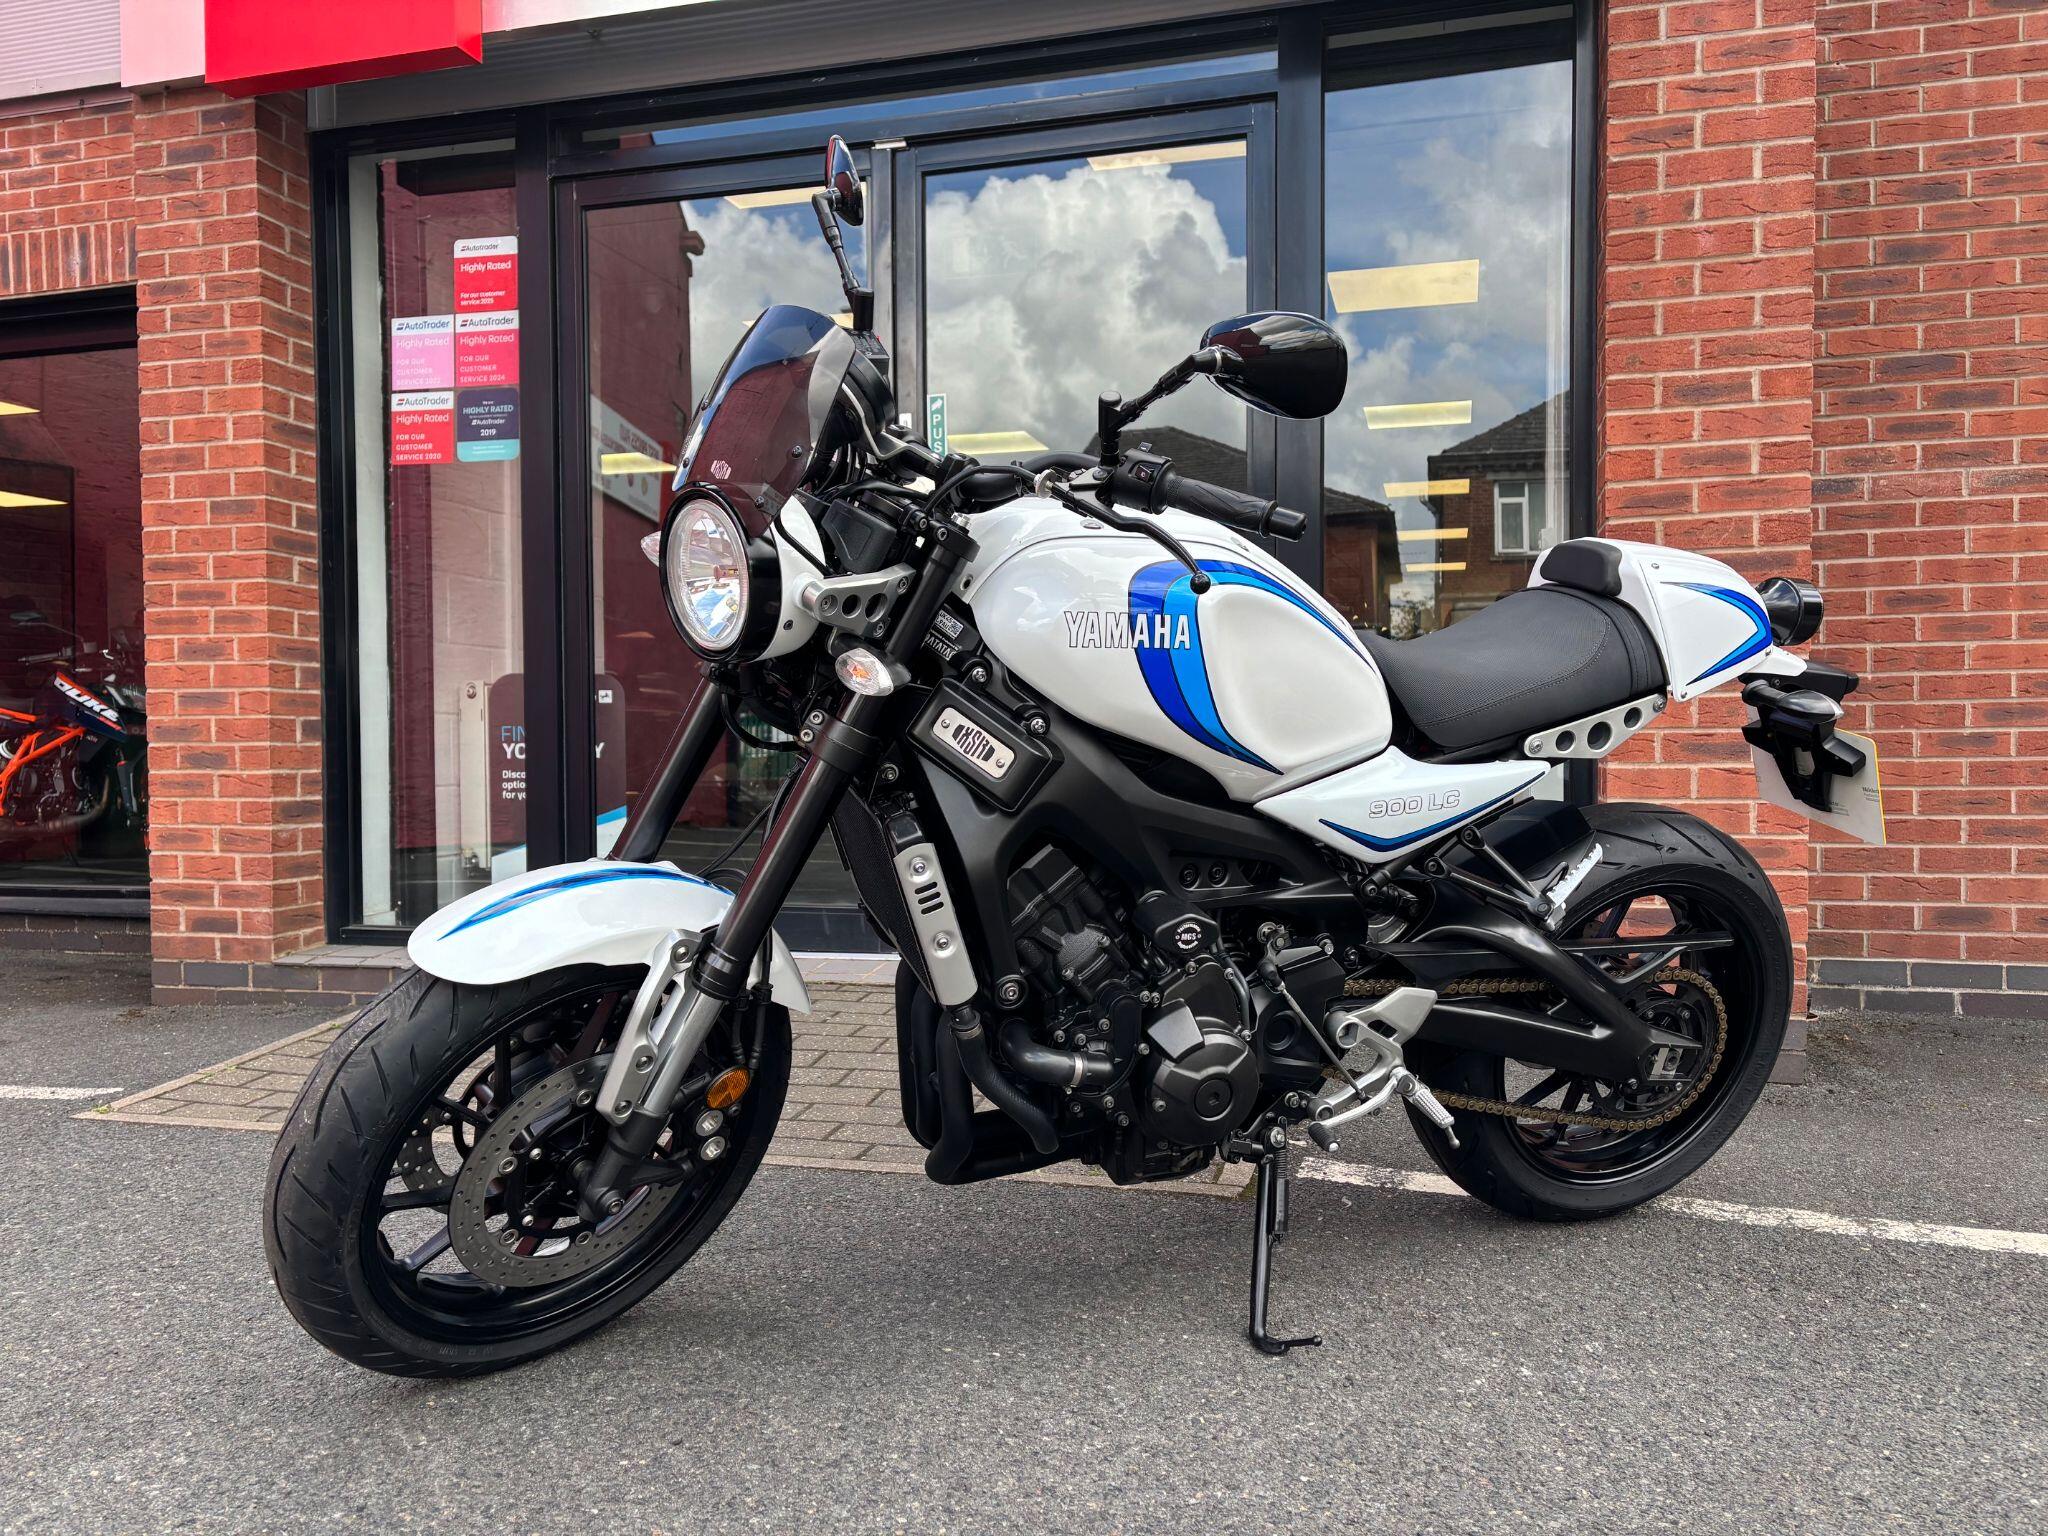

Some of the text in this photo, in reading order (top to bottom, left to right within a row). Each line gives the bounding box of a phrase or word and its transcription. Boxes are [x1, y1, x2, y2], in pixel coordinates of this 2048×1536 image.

[460, 260, 512, 274] Highly Rated
[404, 320, 450, 331] AutoTrader
[468, 316, 514, 327] AutoTrader
[397, 336, 449, 349] Highly Rated
[460, 333, 514, 346] Highly Rated
[460, 364, 497, 373] CUSTOMER
[460, 374, 487, 383] SERVICE
[405, 396, 450, 406] AutoTrader
[462, 404, 514, 415] HIGHLY RATED
[396, 412, 449, 426] Highly Rated
[396, 433, 410, 441] FOR
[480, 428, 497, 437] 2019
[933, 414, 943, 453] PUS
[396, 443, 433, 451] CUSTOMER
[396, 453, 423, 461] SERVICE
[1064, 611, 1191, 649] YAMAHA
[54, 676, 119, 722] DUKE
[501, 726, 525, 742] FIN
[955, 725, 991, 761] XSR
[502, 742, 526, 759] YO
[502, 770, 526, 779] Disco
[502, 780, 526, 791] optio
[502, 790, 526, 800] for yo
[1368, 790, 1460, 818] 900 LC
[1181, 932, 1197, 940] MGS
